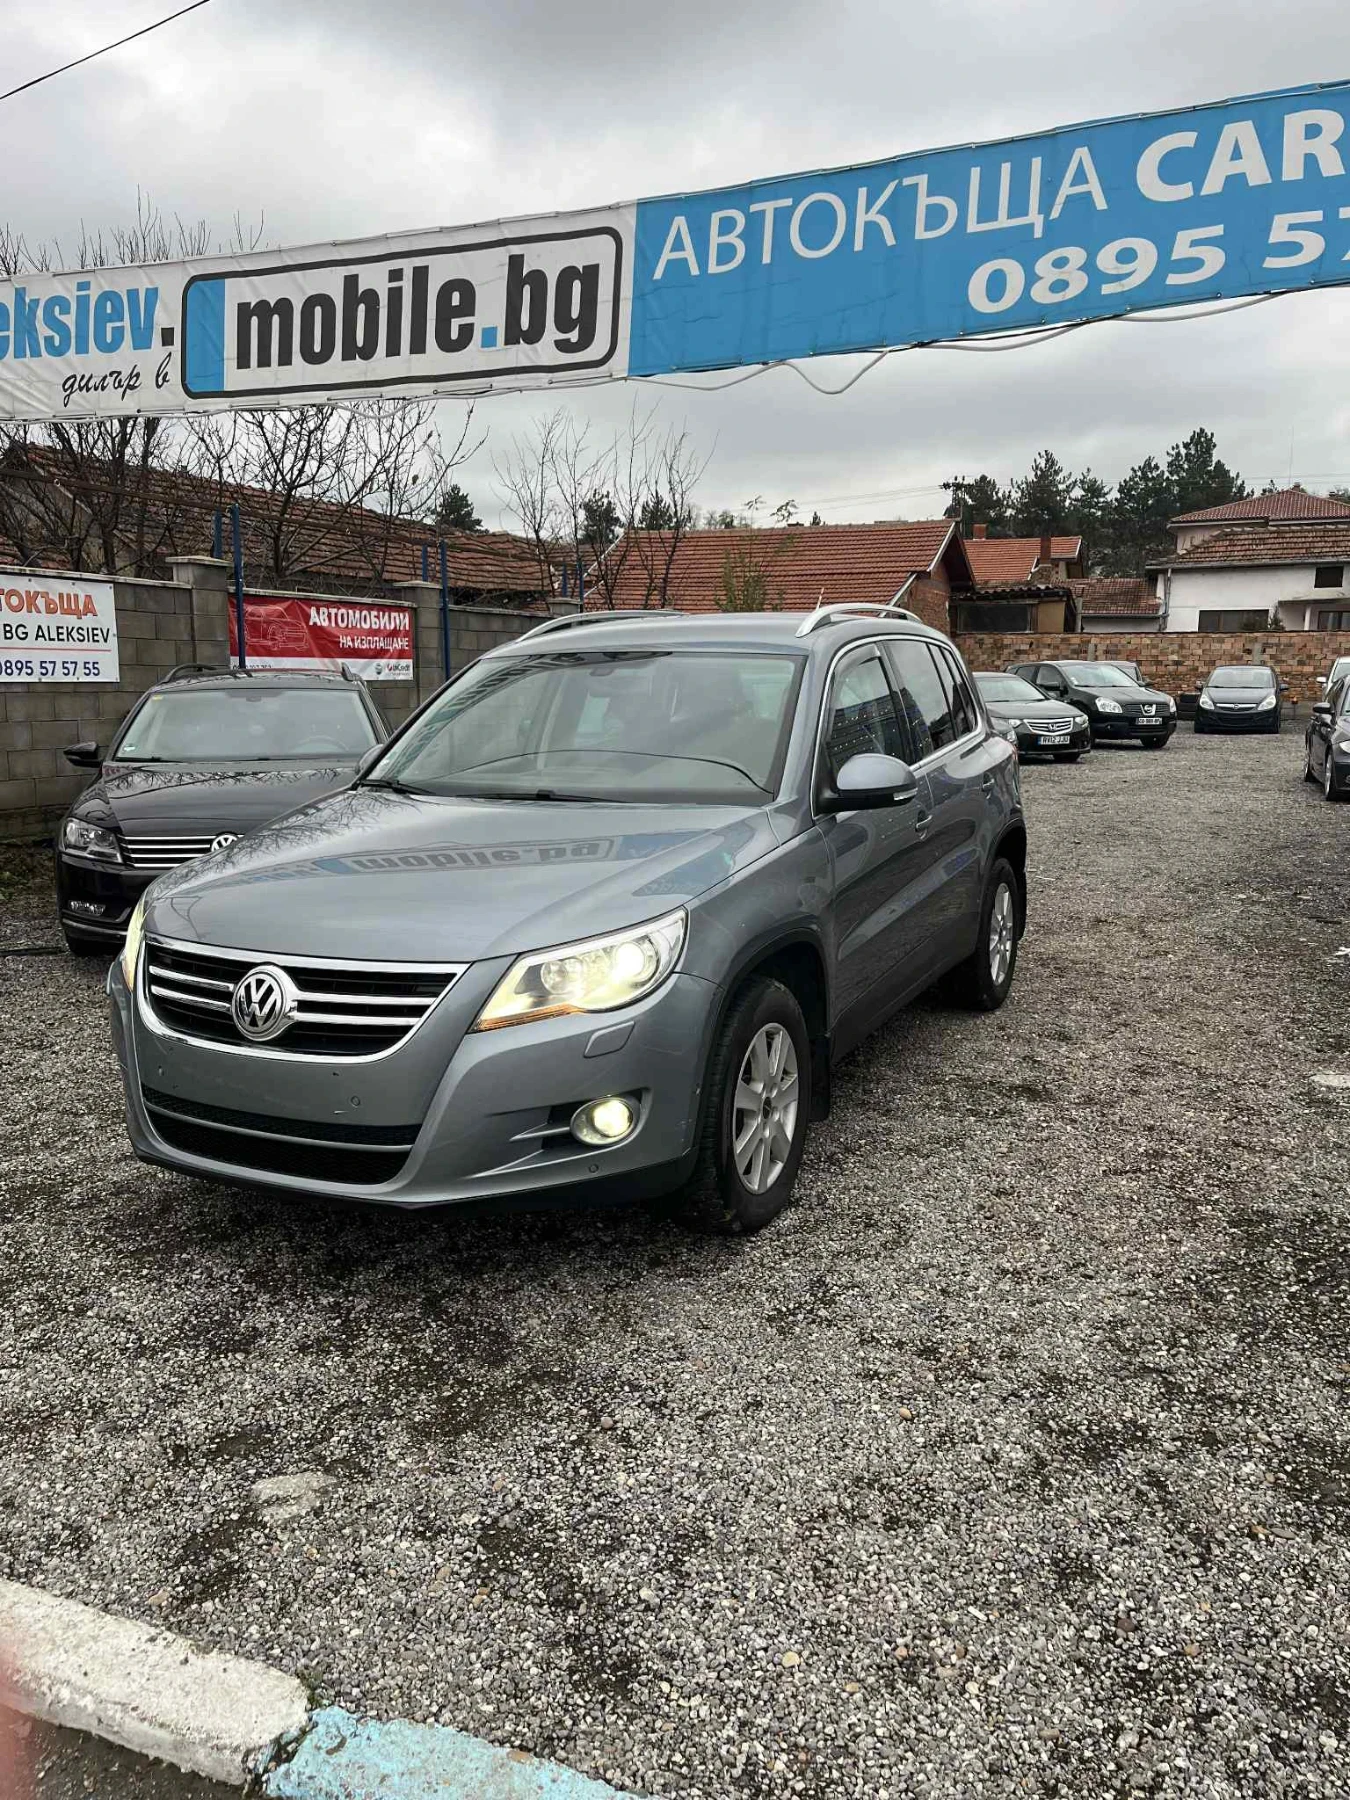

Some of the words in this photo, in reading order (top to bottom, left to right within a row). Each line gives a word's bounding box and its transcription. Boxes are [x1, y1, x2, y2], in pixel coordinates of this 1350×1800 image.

[652, 147, 1108, 280] АВТОКЪЩА
[1136, 109, 1346, 202] CAR
[967, 223, 1227, 314] 0895
[1262, 206, 1350, 269] 5
[236, 253, 600, 370] mobile.bg
[62, 364, 142, 407] дилър
[3, 623, 28, 640] BG
[35, 624, 110, 643] ALEKSIEV
[309, 606, 410, 631] АВТОМОБИЛИ
[340, 635, 353, 648] НА
[354, 636, 409, 652] ИЗПЛАЩАНЕ
[40, 661, 56, 676] 57
[62, 661, 78, 676] 57
[84, 661, 100, 676] 55
